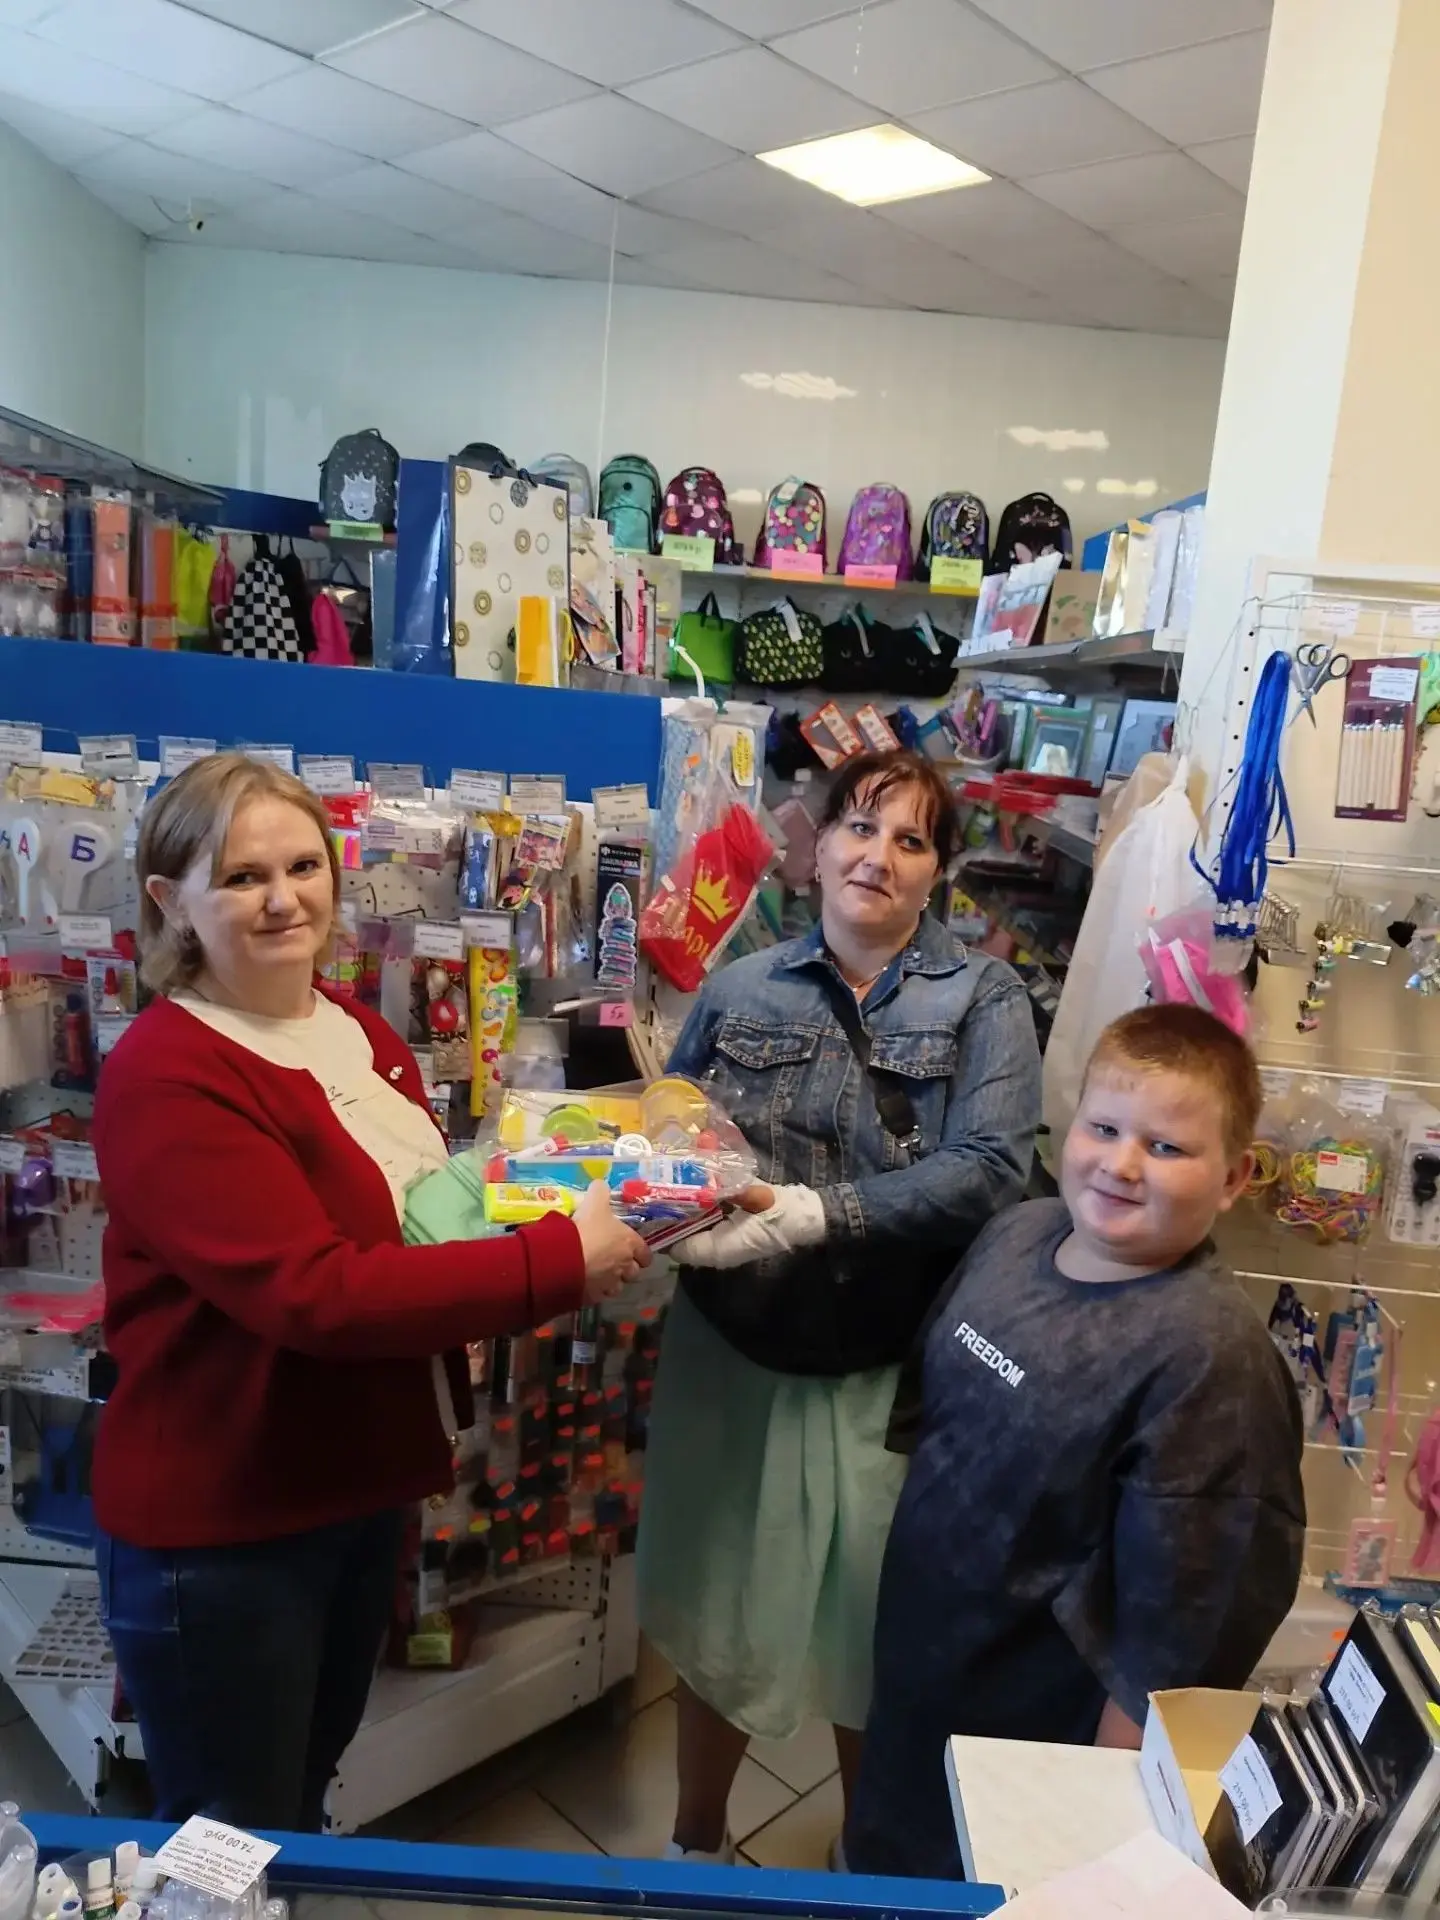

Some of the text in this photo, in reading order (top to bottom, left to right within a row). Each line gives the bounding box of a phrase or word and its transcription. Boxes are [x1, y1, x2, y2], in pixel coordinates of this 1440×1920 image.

[70, 833, 97, 863] Б
[954, 1321, 1026, 1388] FREEDOM
[202, 1828, 227, 1843] руб.
